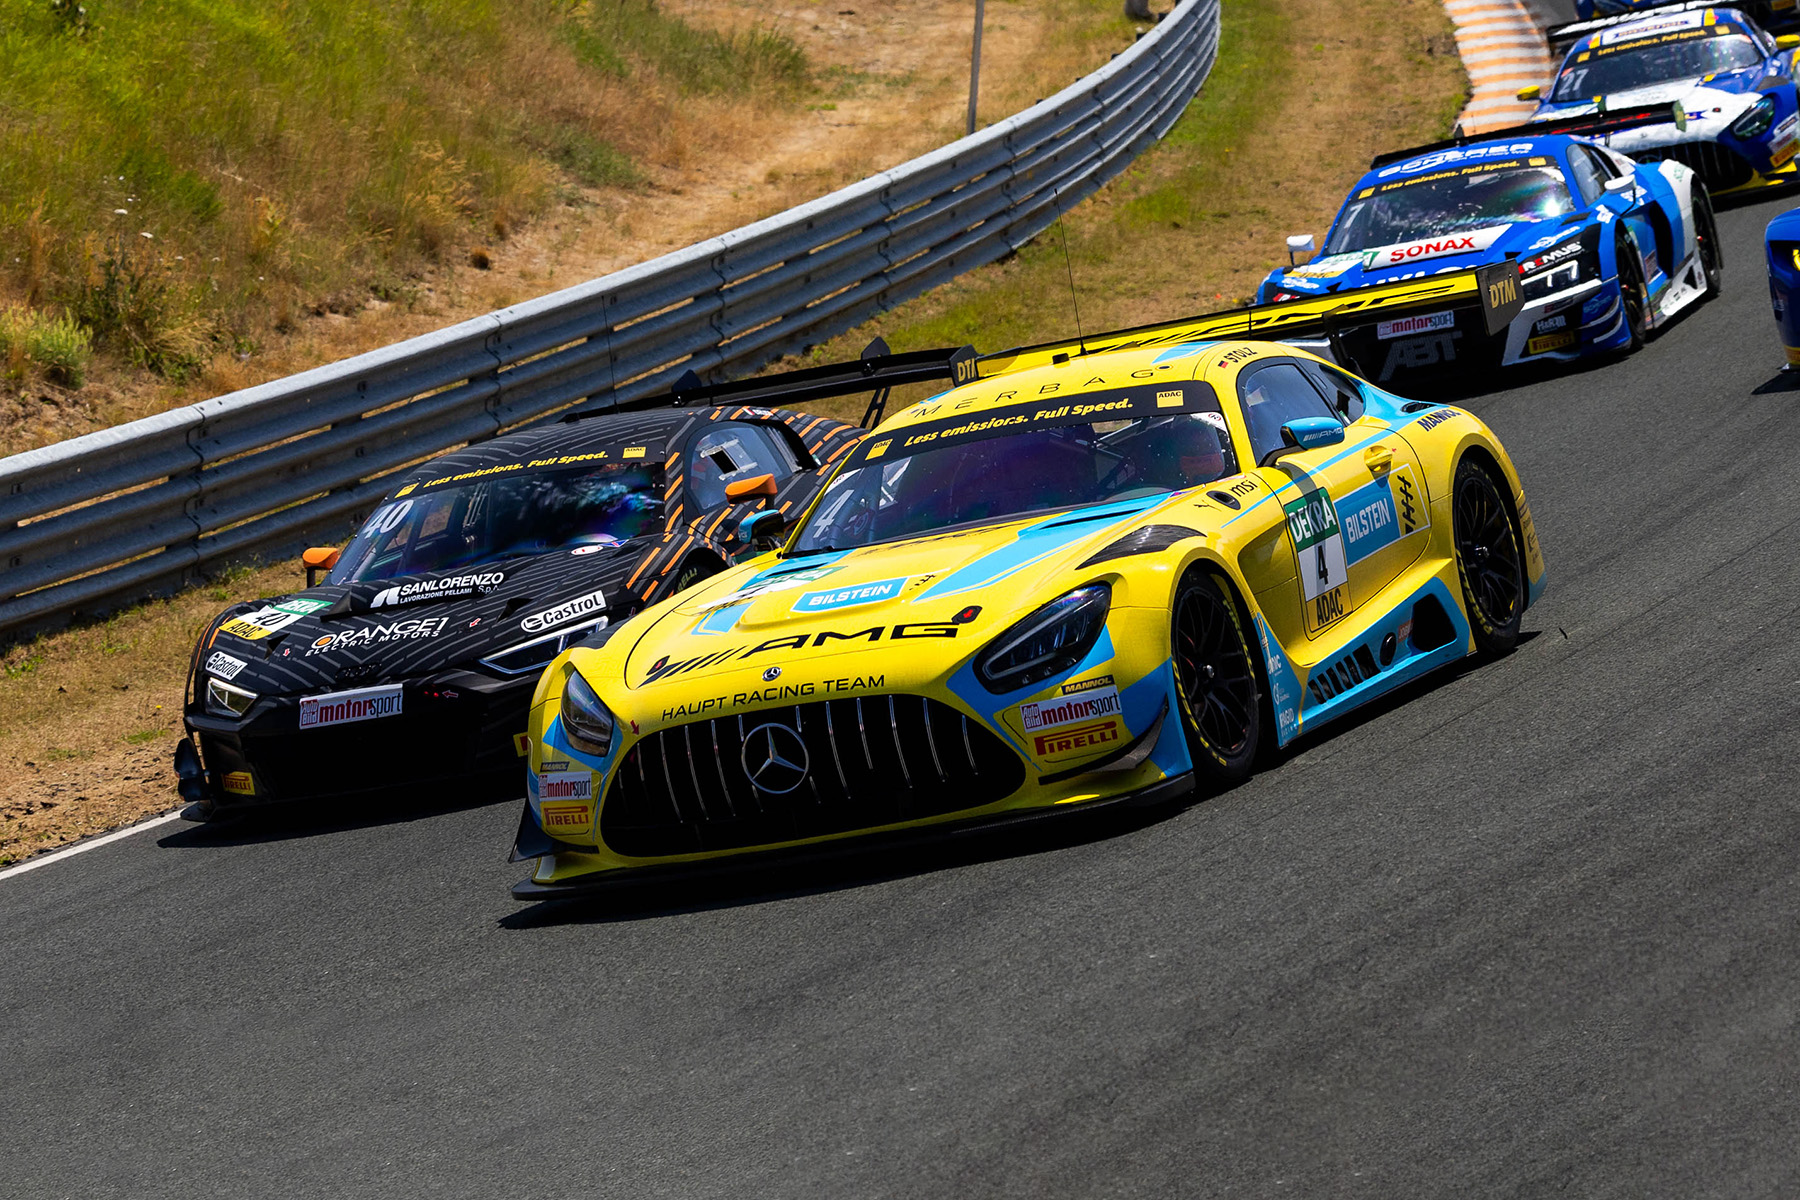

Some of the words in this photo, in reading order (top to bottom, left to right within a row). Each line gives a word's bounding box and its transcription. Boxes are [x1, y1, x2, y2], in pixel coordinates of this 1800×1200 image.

[1558, 69, 1589, 95] 27
[1381, 181, 1404, 192] Less
[1461, 164, 1484, 176] Full
[1484, 161, 1521, 173] Speed.
[1344, 203, 1365, 229] 7
[1390, 236, 1475, 263] SONAX
[1522, 241, 1582, 272] REMUS
[1490, 278, 1517, 309] DTM
[1392, 313, 1454, 334] motorsport
[1224, 347, 1258, 364] STOLZ
[1378, 330, 1463, 383] ABT
[914, 368, 1154, 419] MERBAG
[1158, 390, 1182, 399] ADAC
[904, 431, 939, 447] Less
[1033, 406, 1069, 421] Full
[1071, 397, 1133, 416] Speed.
[1319, 427, 1343, 439] AMG
[423, 475, 451, 488] Less
[453, 463, 523, 481] emissions.
[527, 457, 558, 468] Full
[559, 450, 608, 465] Speed.
[1229, 480, 1258, 498] msi
[364, 499, 414, 539] 40
[812, 489, 854, 538] 4
[1288, 495, 1336, 543] DEKRA
[1344, 497, 1391, 544] BILSTEIN
[1317, 544, 1329, 586] 4
[401, 571, 505, 596] SANLORENZO
[677, 567, 698, 593] RELLI
[400, 590, 444, 604] LAVORAZIONE
[444, 587, 473, 598] PELLAMI
[809, 584, 893, 606] BILSTEIN
[1316, 588, 1343, 627] ADAC
[252, 611, 286, 627] 40
[543, 594, 603, 625] Castrol
[226, 620, 263, 639] ADAC
[305, 637, 371, 657] ELECTRIC
[378, 629, 441, 643] MOTORS
[311, 617, 450, 649] ORANGE1
[737, 622, 960, 660] AMG
[212, 655, 242, 679] Castrol
[662, 696, 727, 721] HAUPT
[732, 682, 815, 706] RACING
[823, 674, 885, 693] TEAM
[1065, 677, 1112, 693] MANNOL
[319, 692, 402, 722] motorsport
[1023, 704, 1039, 717] Auto
[1041, 693, 1121, 726] motorsport
[1034, 720, 1118, 756] PIRELLI
[224, 773, 252, 791] PIRELLI
[547, 778, 592, 798] motorsport
[543, 805, 589, 826] PIRELLI
